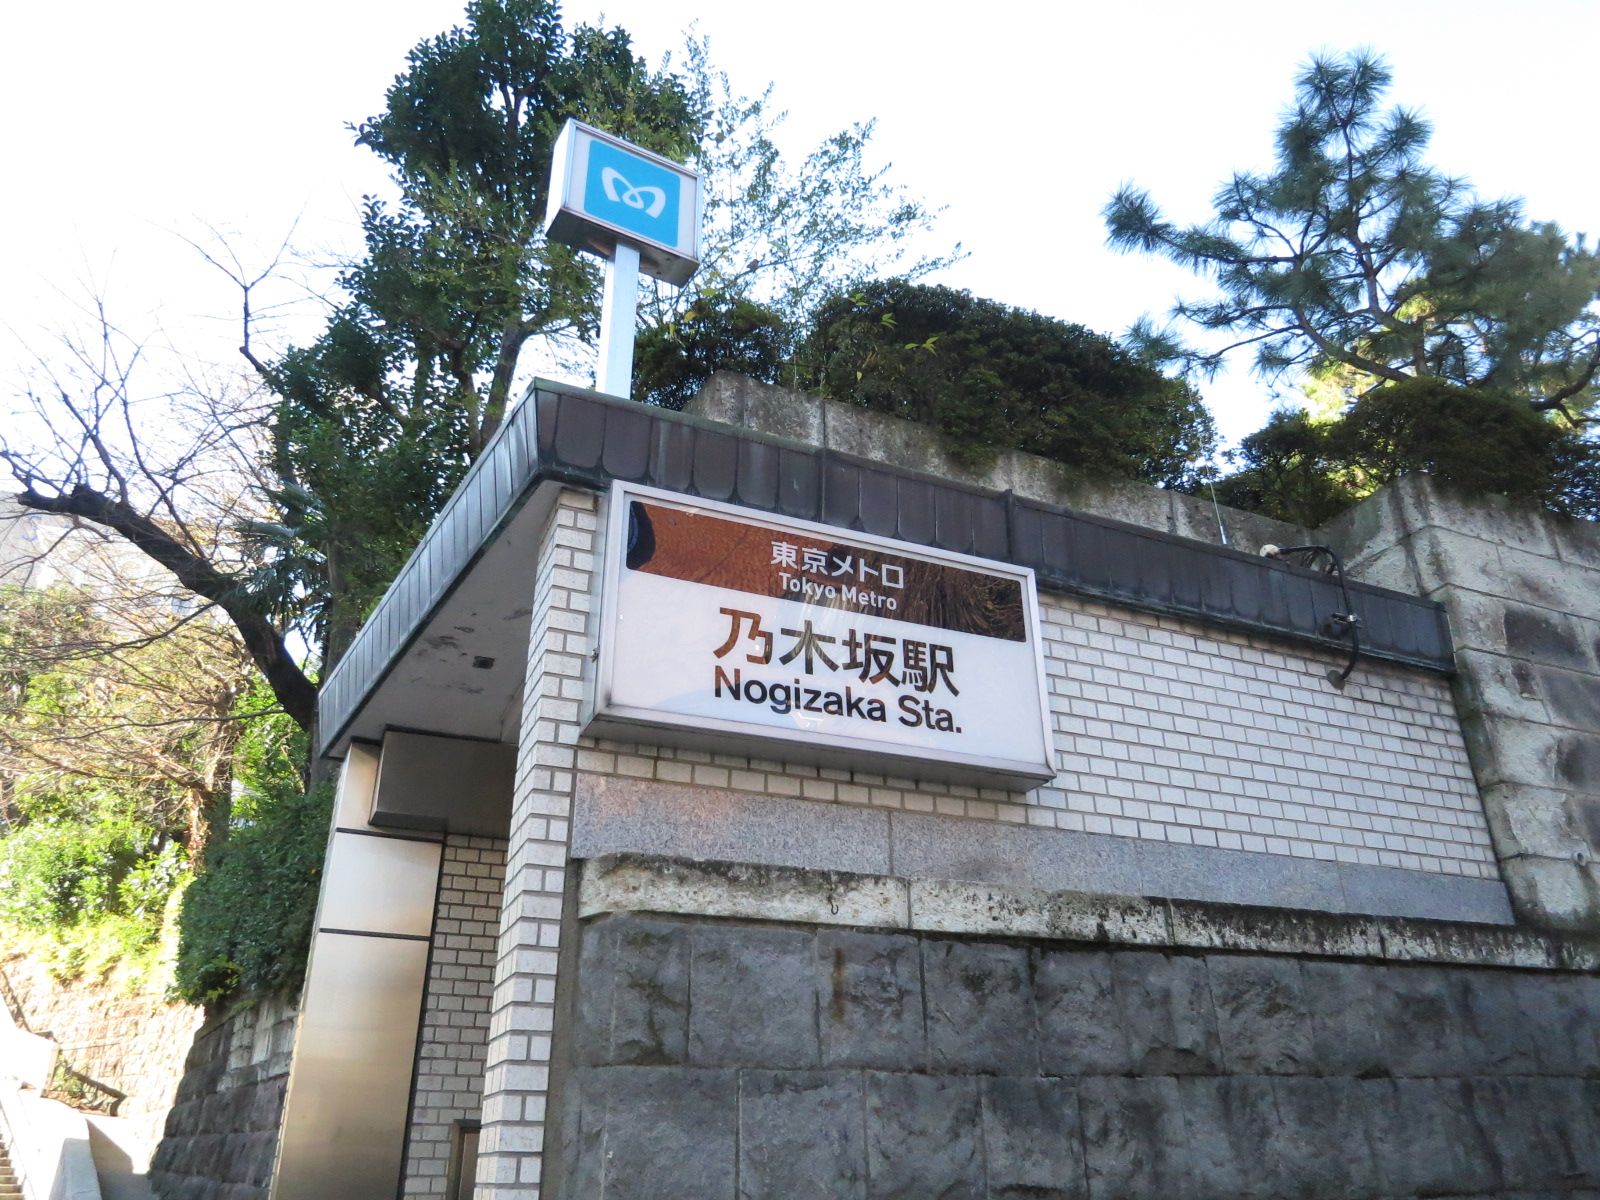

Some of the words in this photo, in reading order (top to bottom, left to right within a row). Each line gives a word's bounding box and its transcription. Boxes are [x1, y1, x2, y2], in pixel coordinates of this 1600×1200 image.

[770, 541, 904, 589] 東京メトロ
[778, 572, 836, 602] Tokyo
[841, 584, 897, 611] Metro
[713, 607, 960, 697] 乃木坂駅
[714, 665, 887, 723] Nogizaka
[898, 695, 962, 734] Sta.
